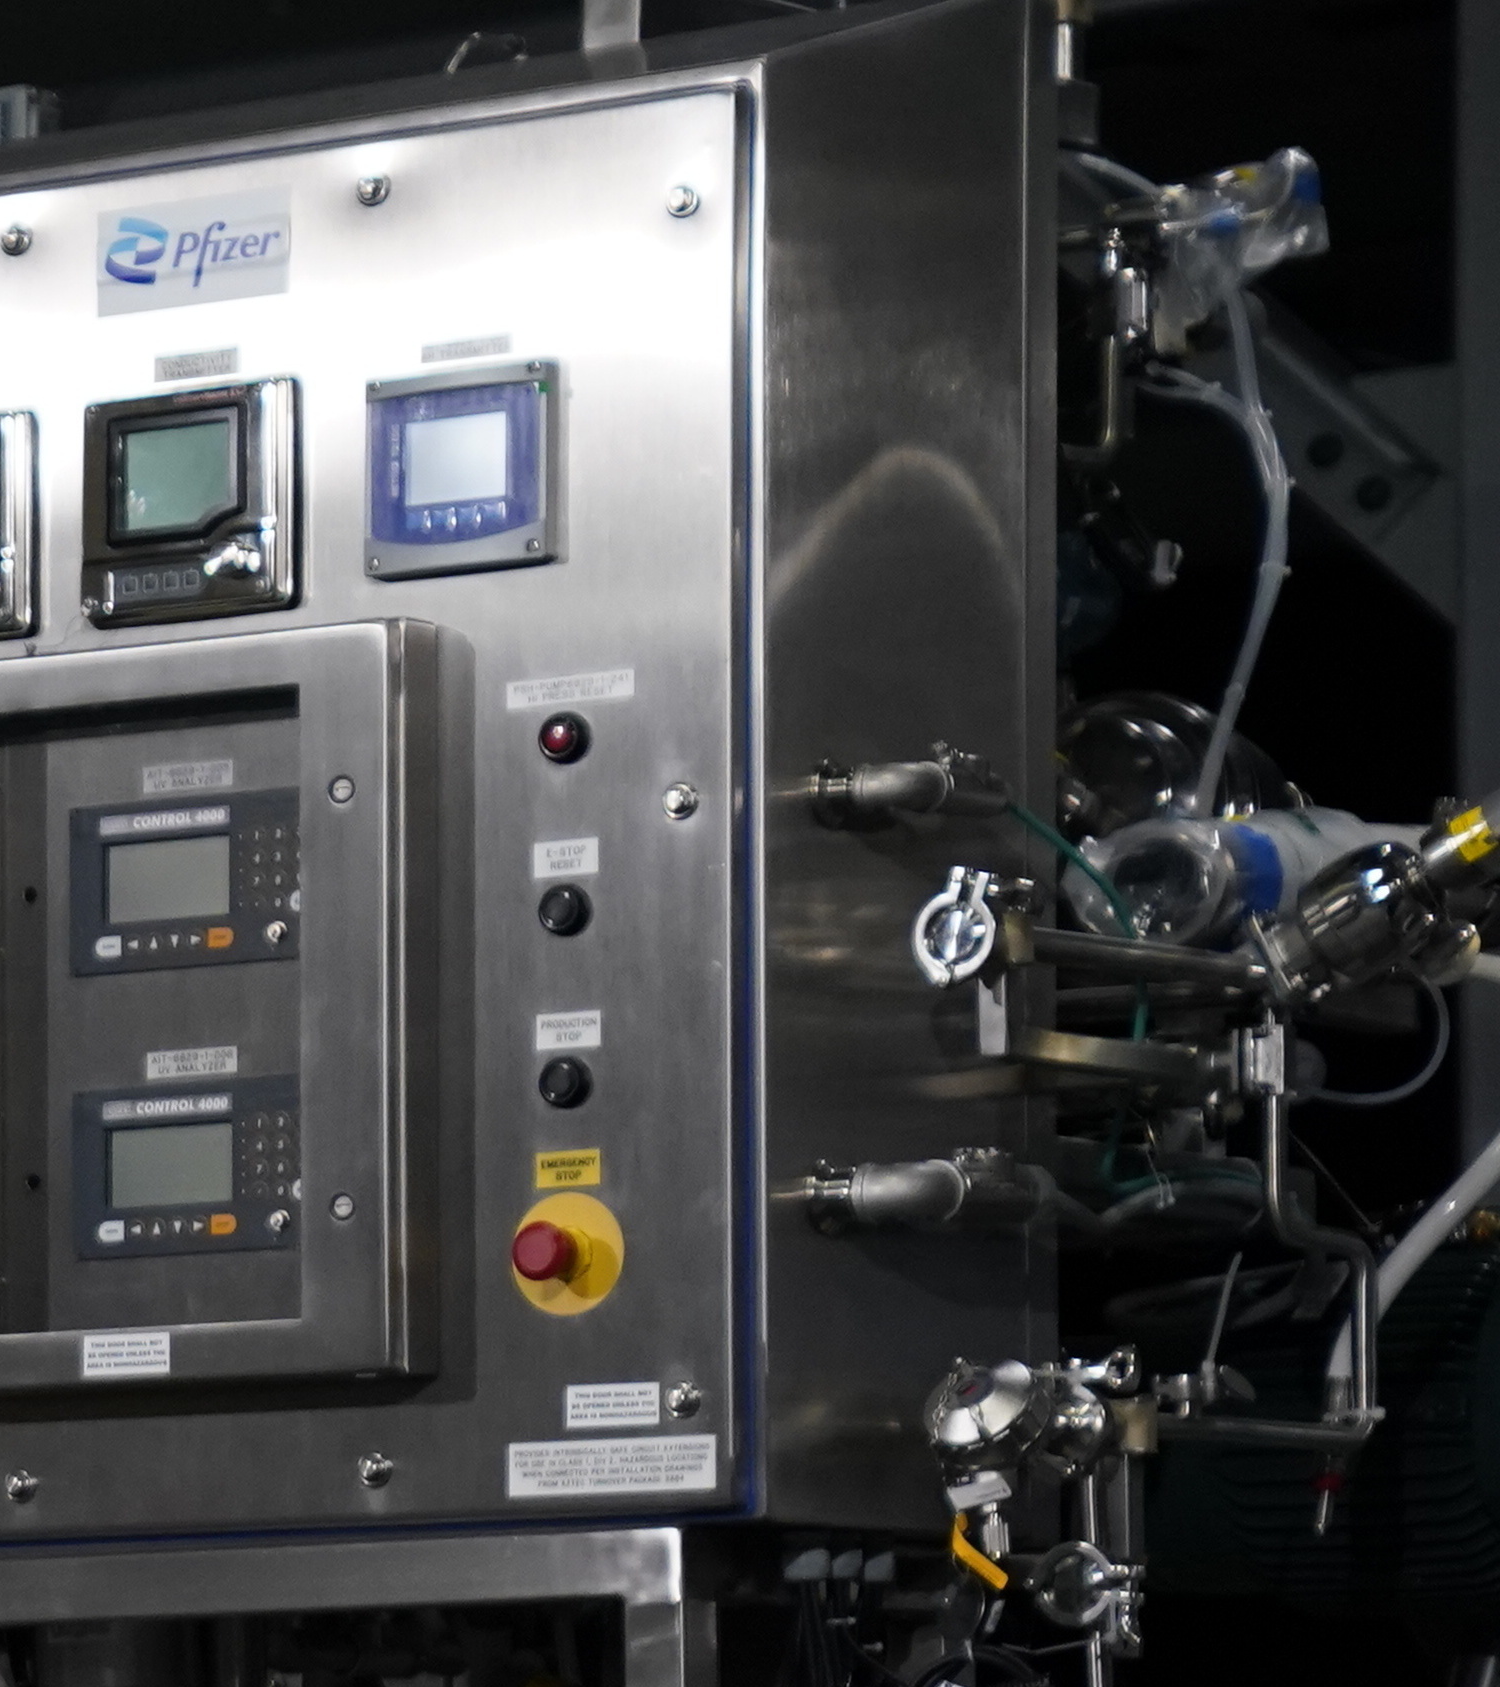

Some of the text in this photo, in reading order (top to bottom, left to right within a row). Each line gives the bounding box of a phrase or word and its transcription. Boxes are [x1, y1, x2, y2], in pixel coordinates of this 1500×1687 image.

[172, 220, 281, 288] Pfizer
[133, 808, 225, 829] CONTROL 4000
[550, 859, 581, 870] RESET
[541, 1017, 597, 1029] PRODUCTION
[556, 1031, 582, 1042] STOP
[136, 1098, 195, 1115] CONTROL
[198, 1096, 229, 1111] 4000
[541, 1156, 596, 1169] EMERGENCY
[555, 1169, 582, 1180] STOP
